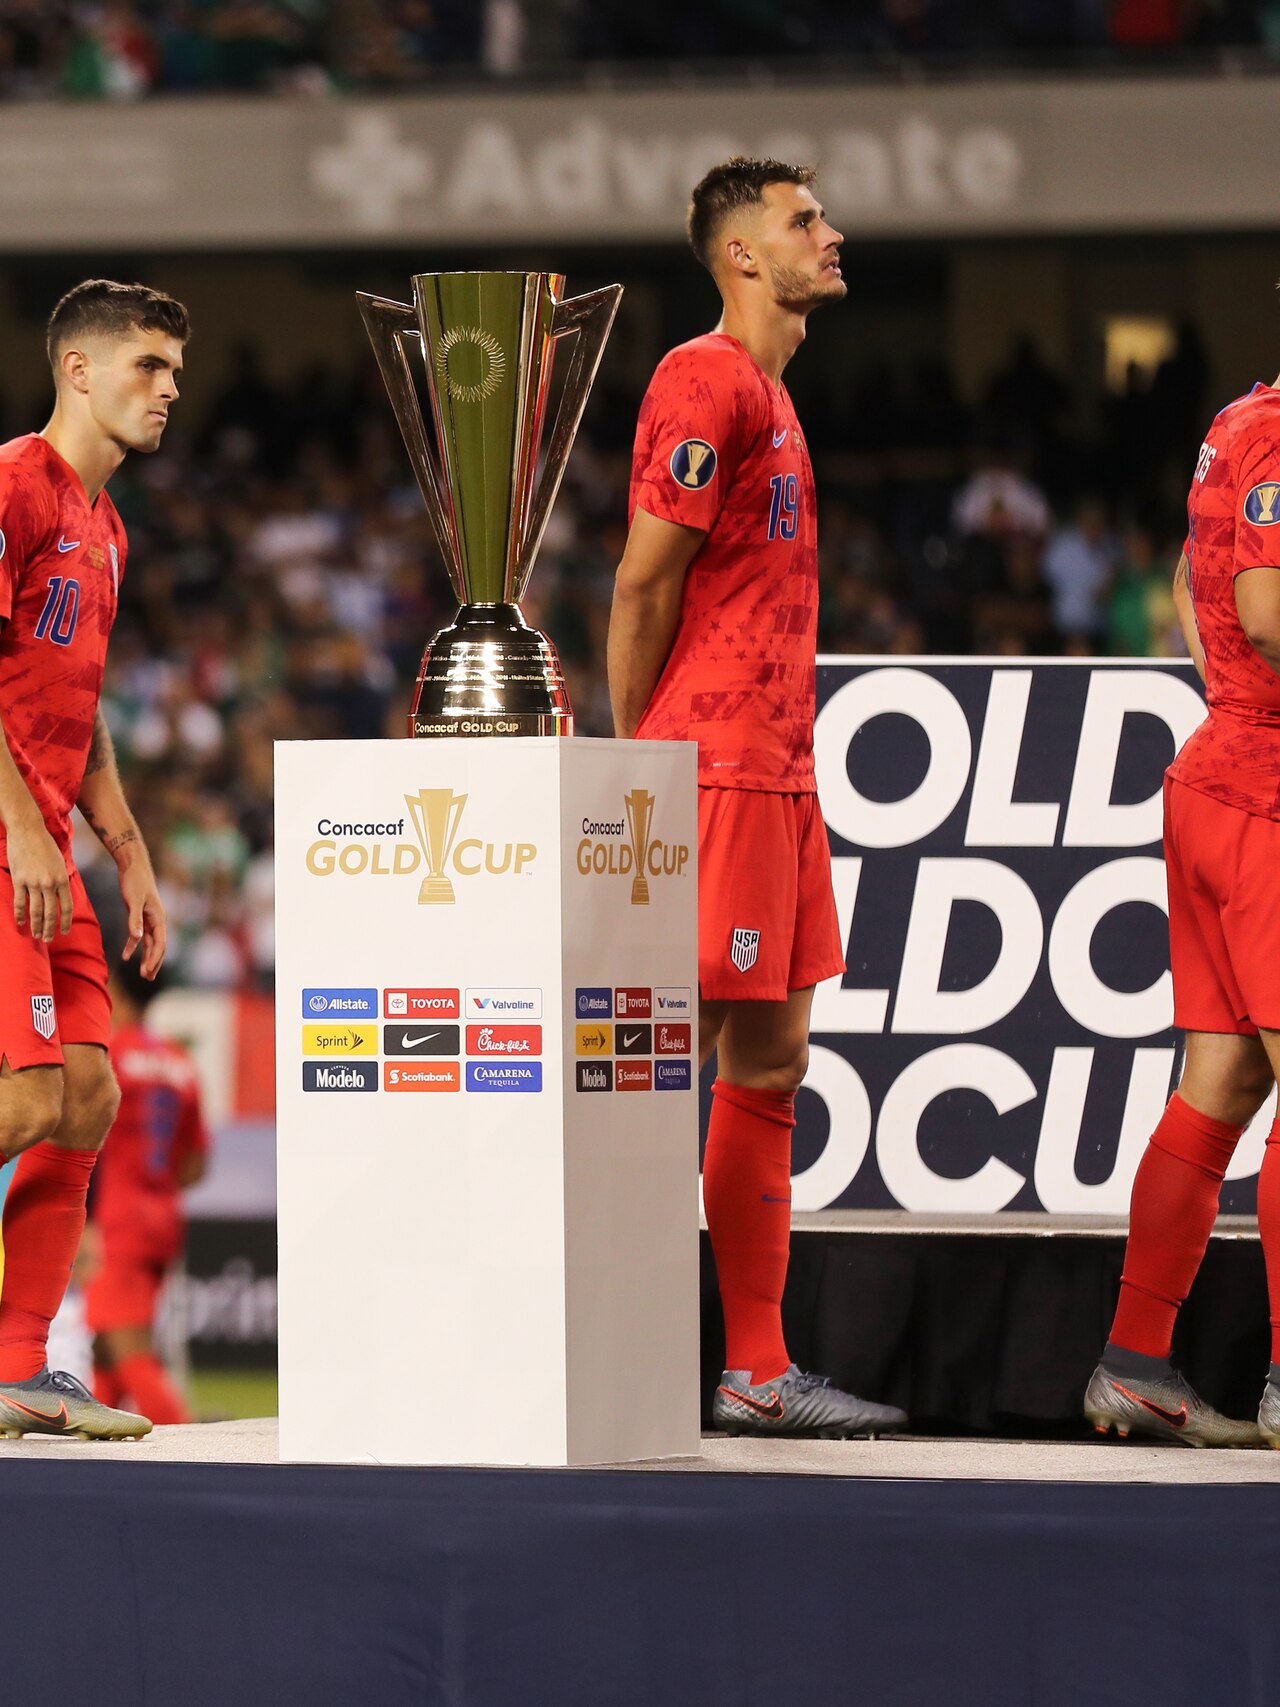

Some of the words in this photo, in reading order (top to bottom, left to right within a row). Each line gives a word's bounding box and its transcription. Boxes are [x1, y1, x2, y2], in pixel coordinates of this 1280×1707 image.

[767, 472, 799, 541] 19
[33, 575, 80, 647] 10
[414, 722, 458, 733] Concacaf
[461, 721, 493, 733] GOLD
[495, 721, 519, 733] CUP
[317, 818, 404, 836] Concacaf
[582, 817, 625, 835] Concacaf
[305, 839, 421, 877] GOLD
[452, 838, 538, 876] CUP
[576, 838, 633, 875] GOLD
[647, 839, 689, 876] CUP
[735, 930, 759, 948] USA
[33, 998, 53, 1014] USA
[328, 998, 369, 1010] Allstate
[411, 998, 455, 1009] TOYOTA
[491, 1000, 534, 1010] Valvoline
[587, 999, 609, 1009] Allstate
[627, 998, 650, 1008] TOYOTA
[316, 1035, 349, 1049] Sprint
[477, 1032, 531, 1053] Chick-fil-A
[582, 1035, 599, 1049] Sprint
[315, 1068, 365, 1089] Modelo
[401, 1071, 454, 1082] Scotiabank
[473, 1066, 533, 1082] CAMARENA
[582, 1068, 607, 1088] Modelo
[623, 1071, 649, 1081] Scotiabank
[658, 1065, 687, 1080] CAMARENA
[488, 1079, 520, 1087] TEQUILA
